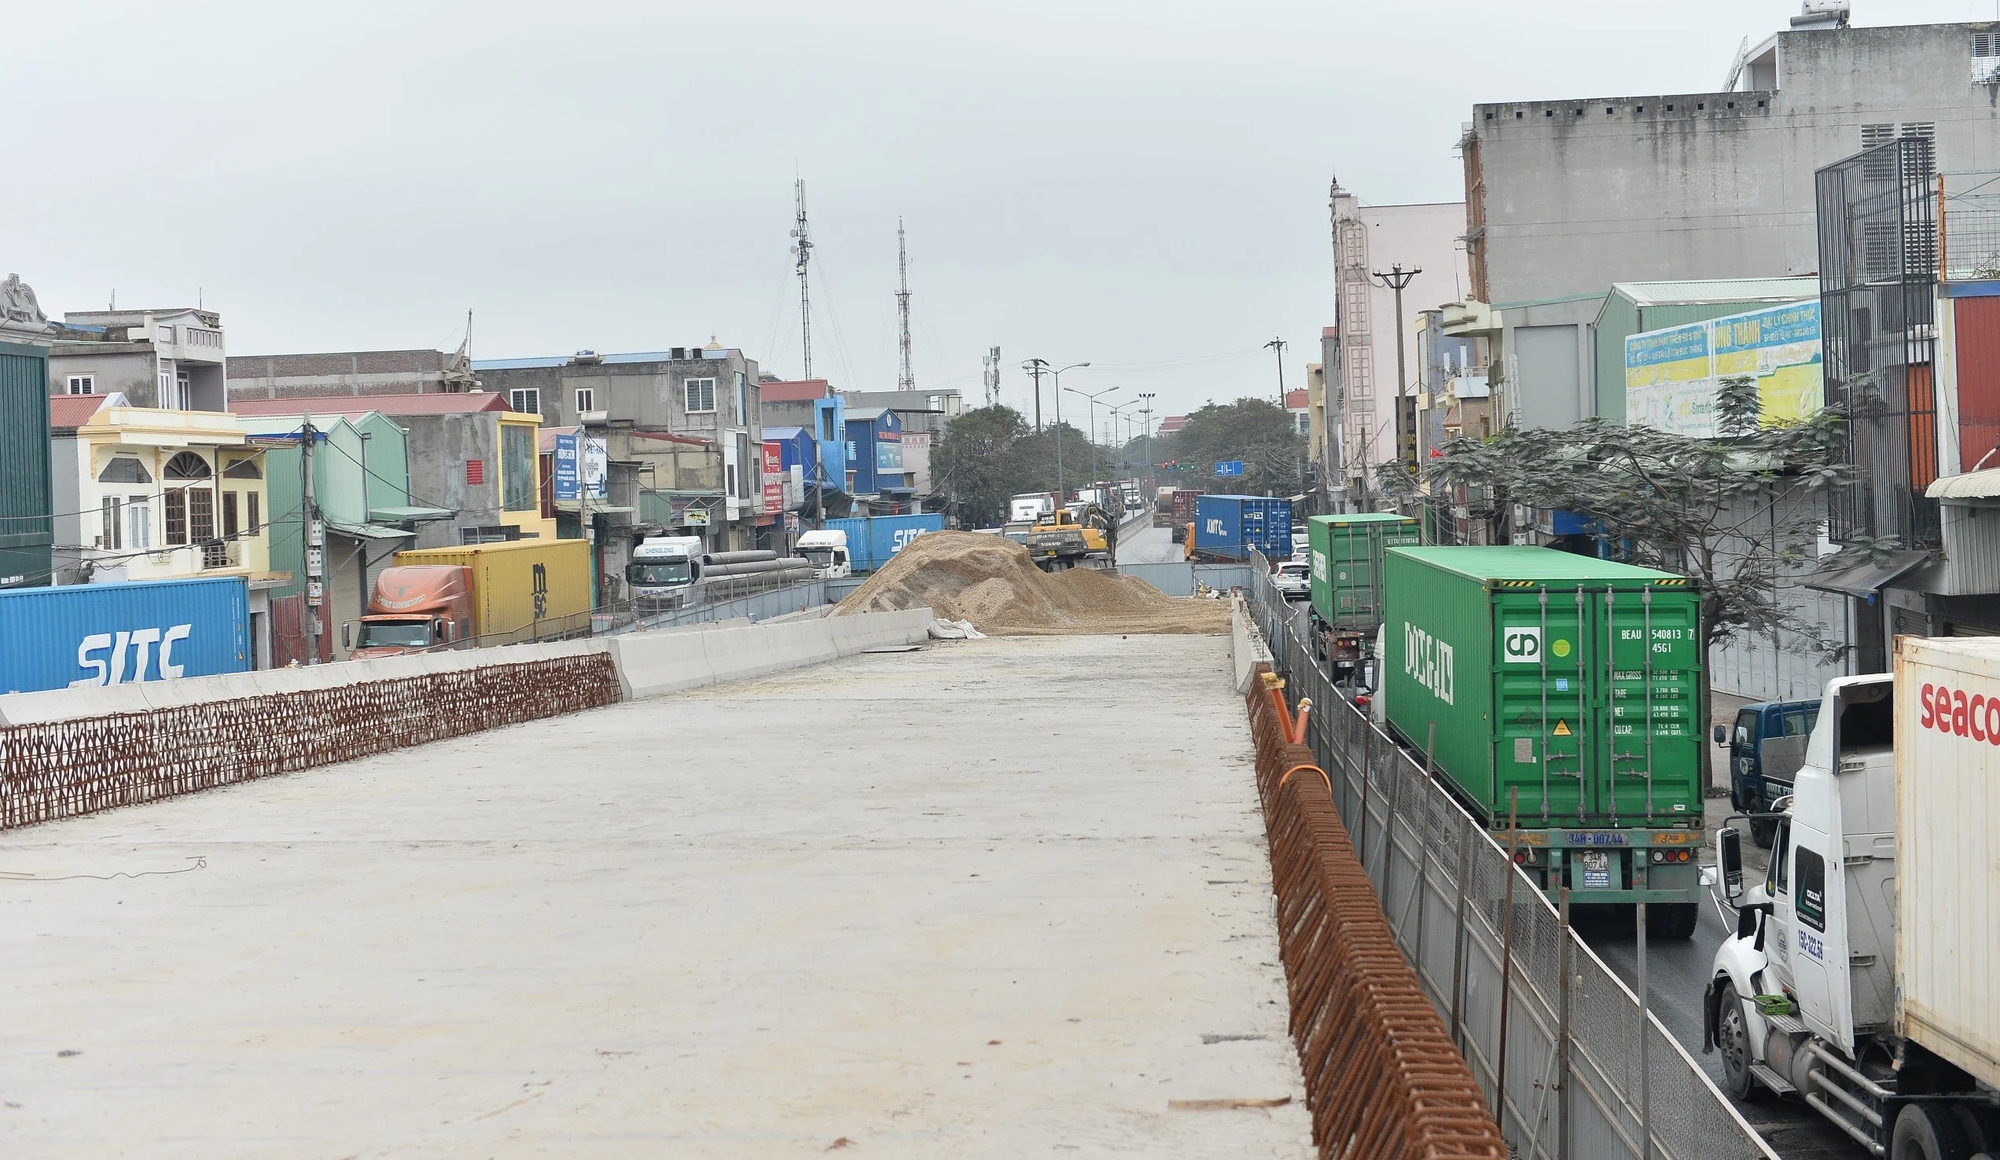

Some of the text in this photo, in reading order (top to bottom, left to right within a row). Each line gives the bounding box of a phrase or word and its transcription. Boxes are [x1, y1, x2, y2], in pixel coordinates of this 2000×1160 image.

[1621, 629, 1695, 640] BEAU 540813 7
[1652, 643, 1672, 653] 45G1
[67, 623, 192, 689] SITC
[1614, 688, 1627, 699] TARE
[1614, 707, 1624, 717] NET
[1920, 682, 2000, 747] seaco
